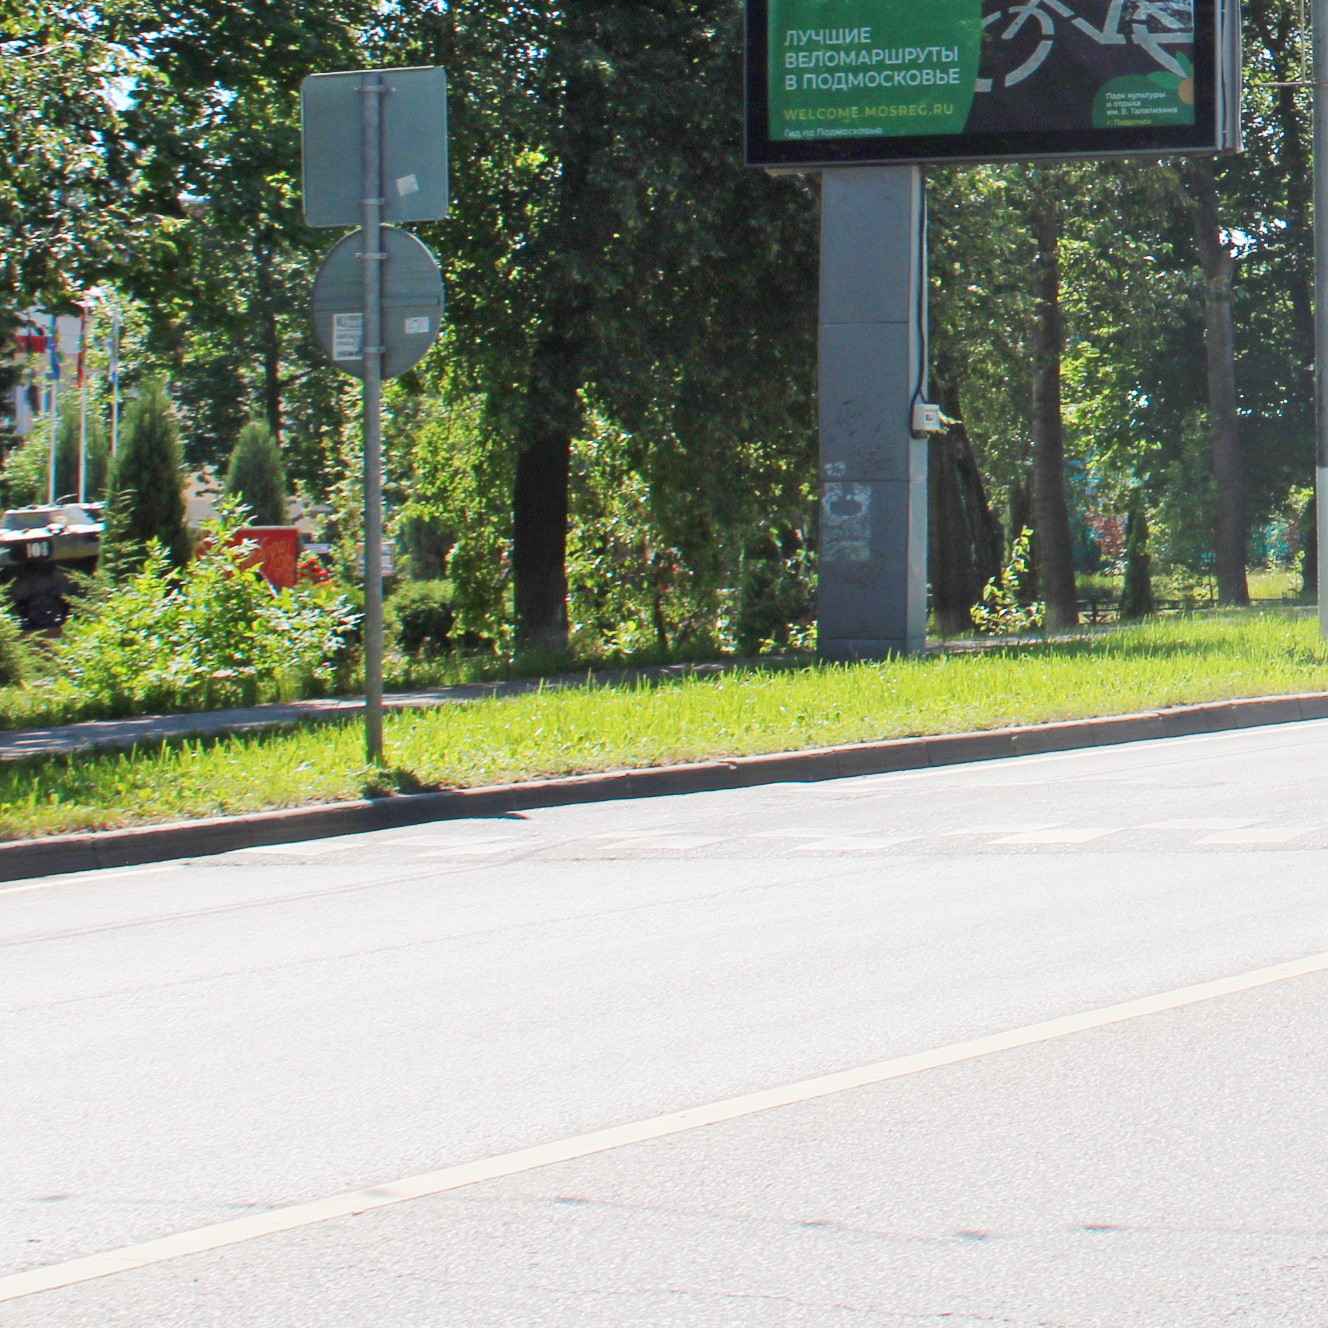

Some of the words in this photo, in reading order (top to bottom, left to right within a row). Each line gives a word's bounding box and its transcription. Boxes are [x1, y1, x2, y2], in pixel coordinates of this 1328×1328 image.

[784, 27, 872, 46] ЛУЧШИЕ
[785, 46, 958, 68] ВЕЛОМАРШРУТЫ
[785, 75, 798, 90] В
[803, 68, 960, 91] ПОДМОСКОВЬЕ
[784, 103, 953, 121] WELCOME.MOSREG.RU
